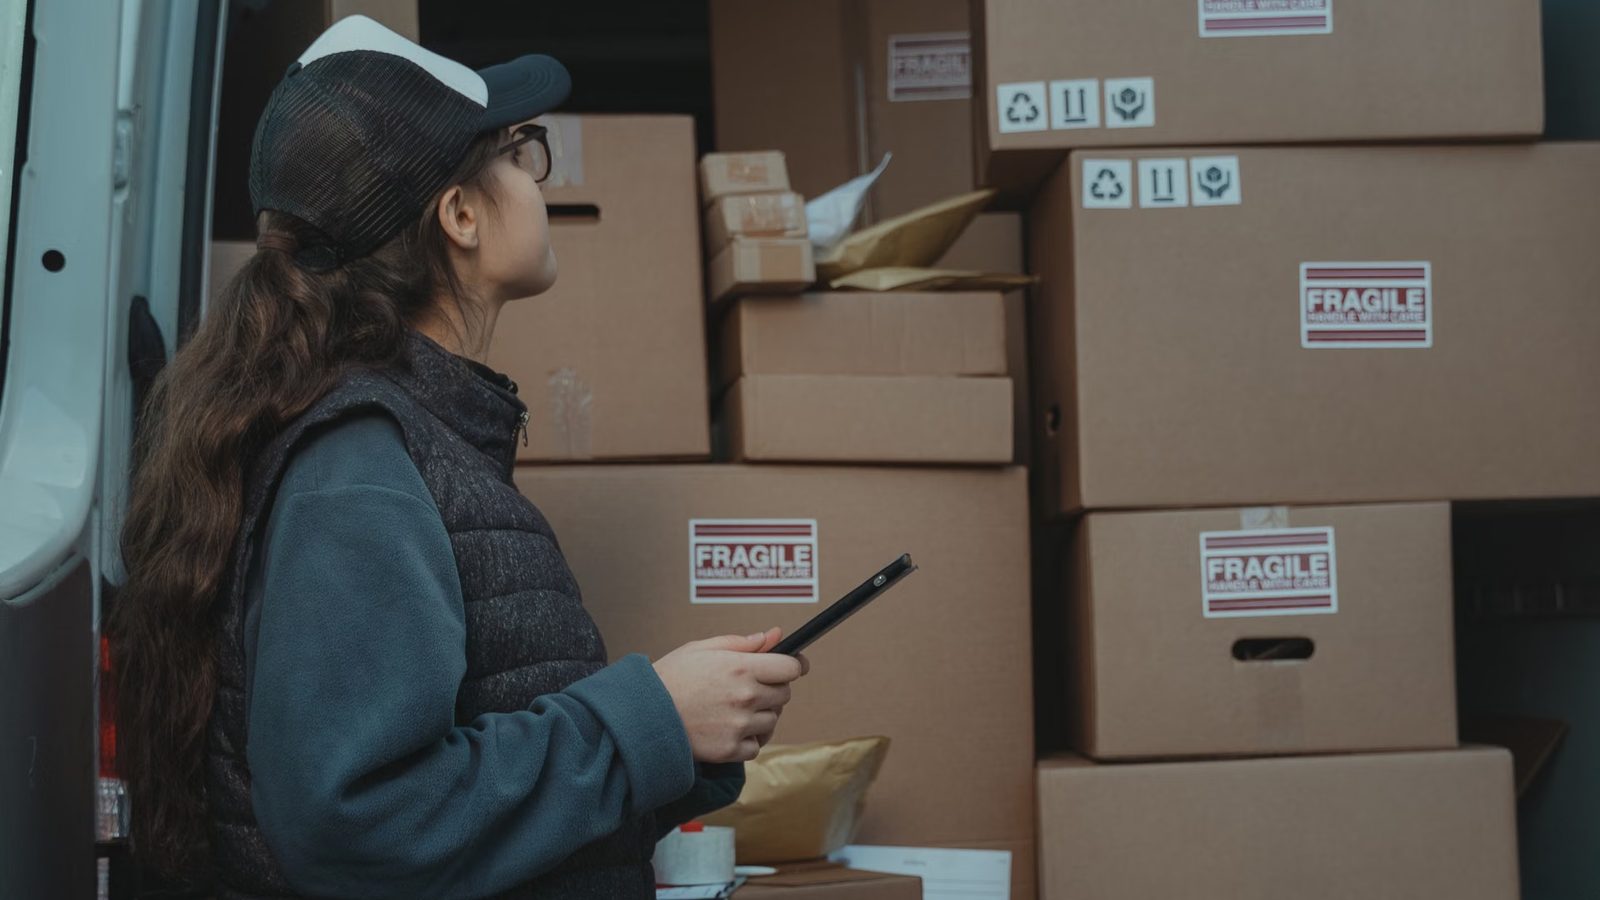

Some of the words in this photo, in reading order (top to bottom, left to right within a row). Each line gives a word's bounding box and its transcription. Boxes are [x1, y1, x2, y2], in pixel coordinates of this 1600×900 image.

[1307, 288, 1424, 312] FRAGILE
[696, 544, 811, 569] FRAGILE
[1207, 554, 1329, 582] FRAGILE
